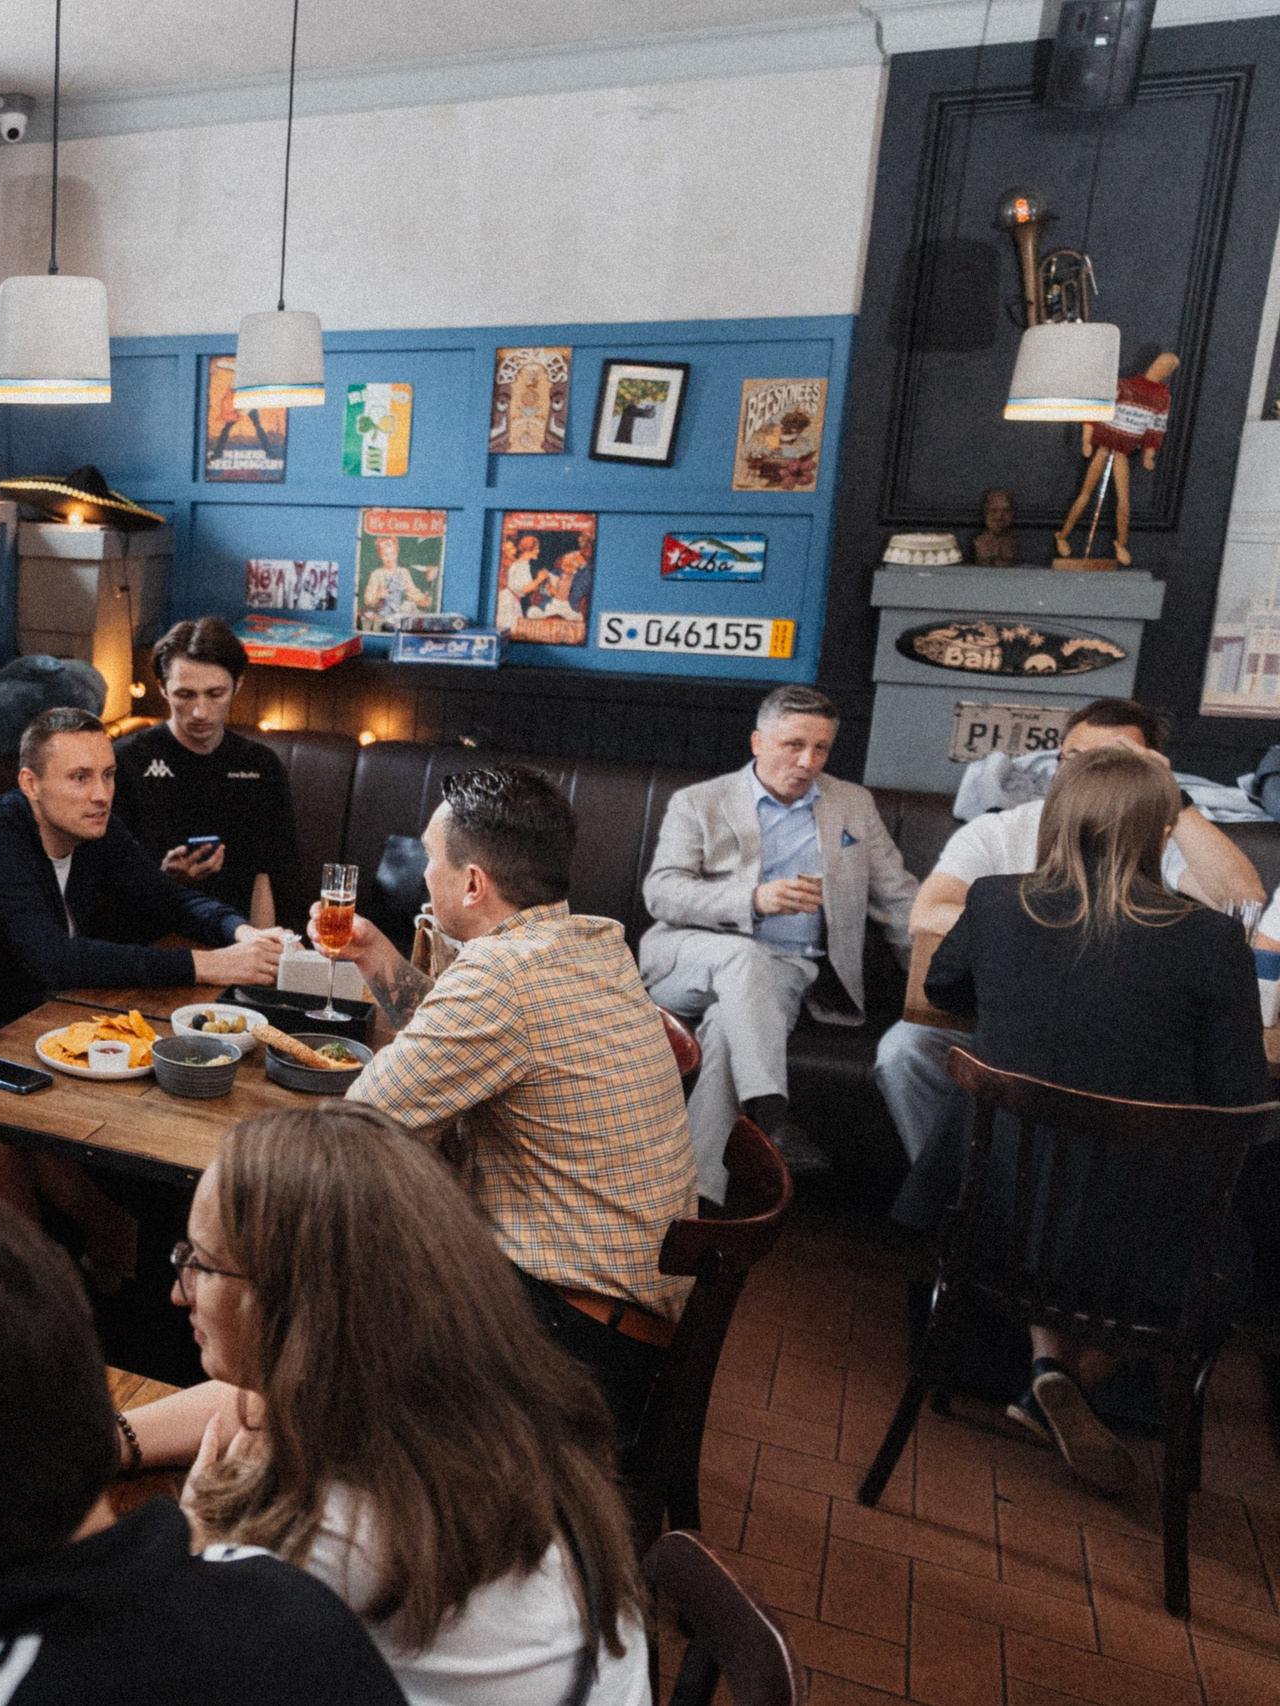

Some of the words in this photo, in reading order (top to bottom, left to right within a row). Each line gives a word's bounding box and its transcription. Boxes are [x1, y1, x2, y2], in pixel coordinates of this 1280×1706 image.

[386, 517, 410, 530] Can
[413, 518, 429, 531] Do
[675, 549, 734, 573] Cuba
[246, 560, 287, 591] New
[293, 560, 338, 594] York
[604, 617, 623, 645] S
[645, 619, 763, 651] 046155
[943, 646, 1003, 673] Bali
